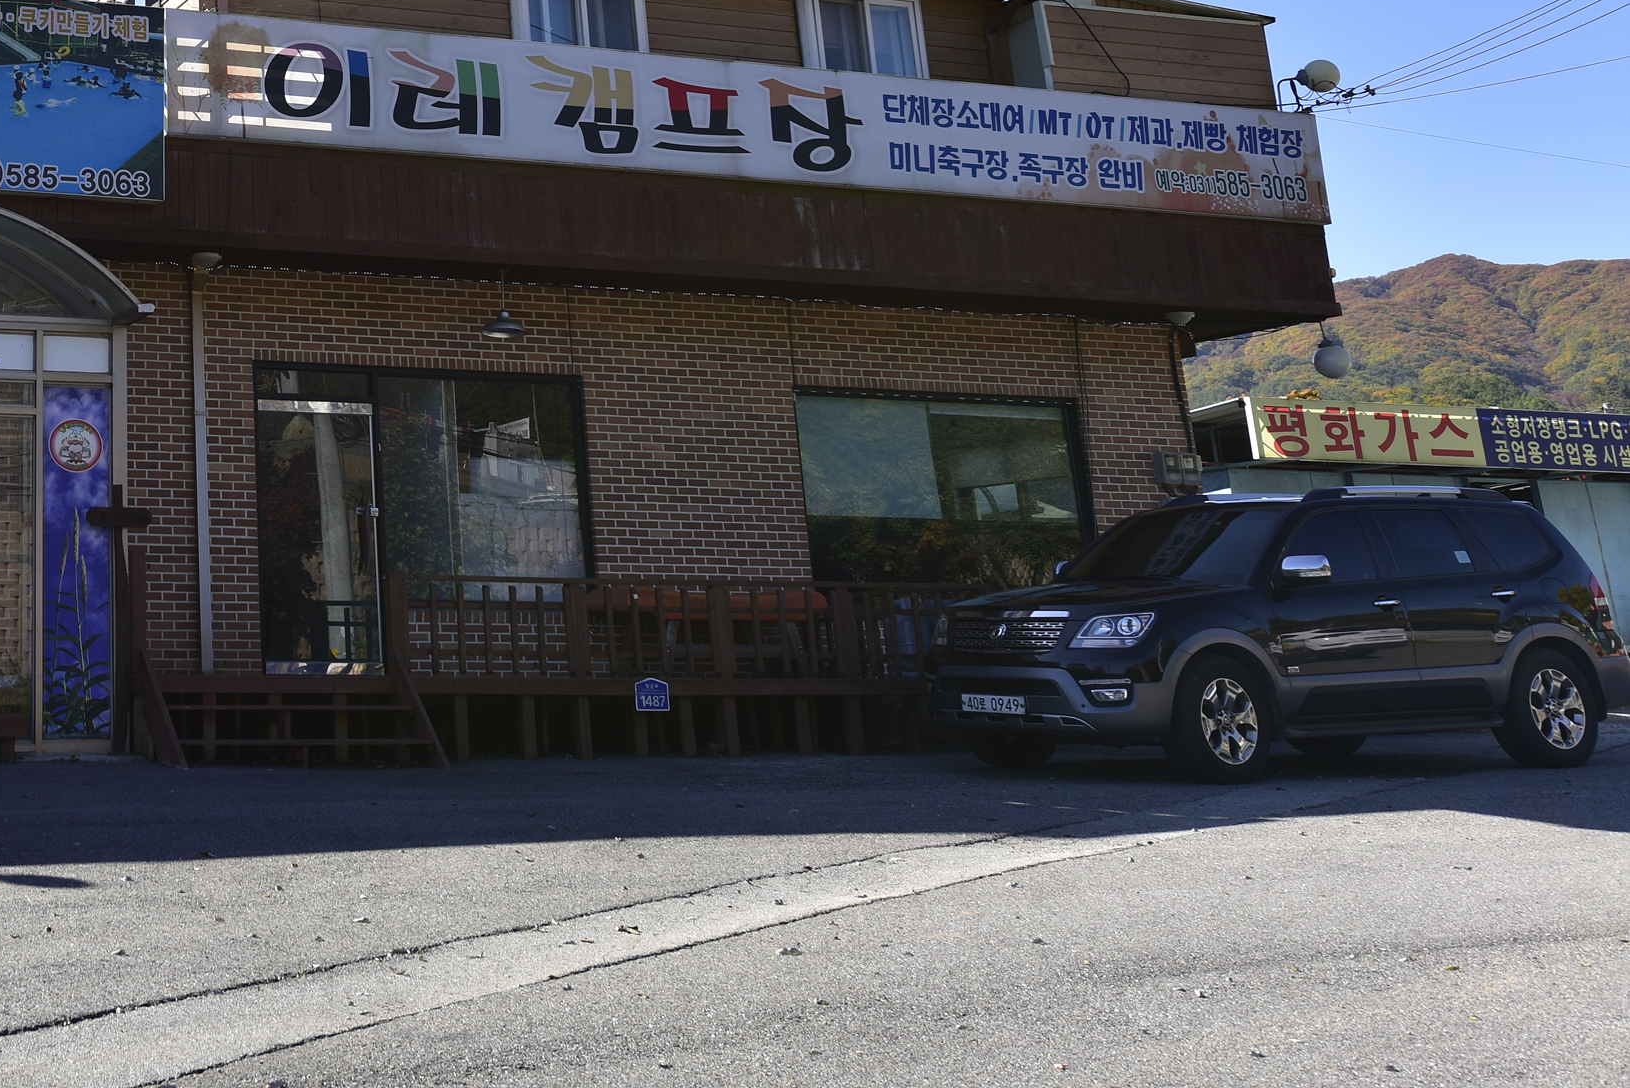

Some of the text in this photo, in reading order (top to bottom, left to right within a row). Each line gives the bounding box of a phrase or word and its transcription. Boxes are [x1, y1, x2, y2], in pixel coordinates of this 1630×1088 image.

[21, 7, 109, 38] 쿠키만들기
[113, 15, 149, 42] 체험
[263, 42, 864, 172] 이레 캠프장
[1236, 122, 1304, 159] 체험장
[1098, 158, 1145, 192] 완비
[1263, 404, 1475, 462] 평화가스
[639, 695, 666, 707] 1487
[990, 697, 1020, 712] 0949
